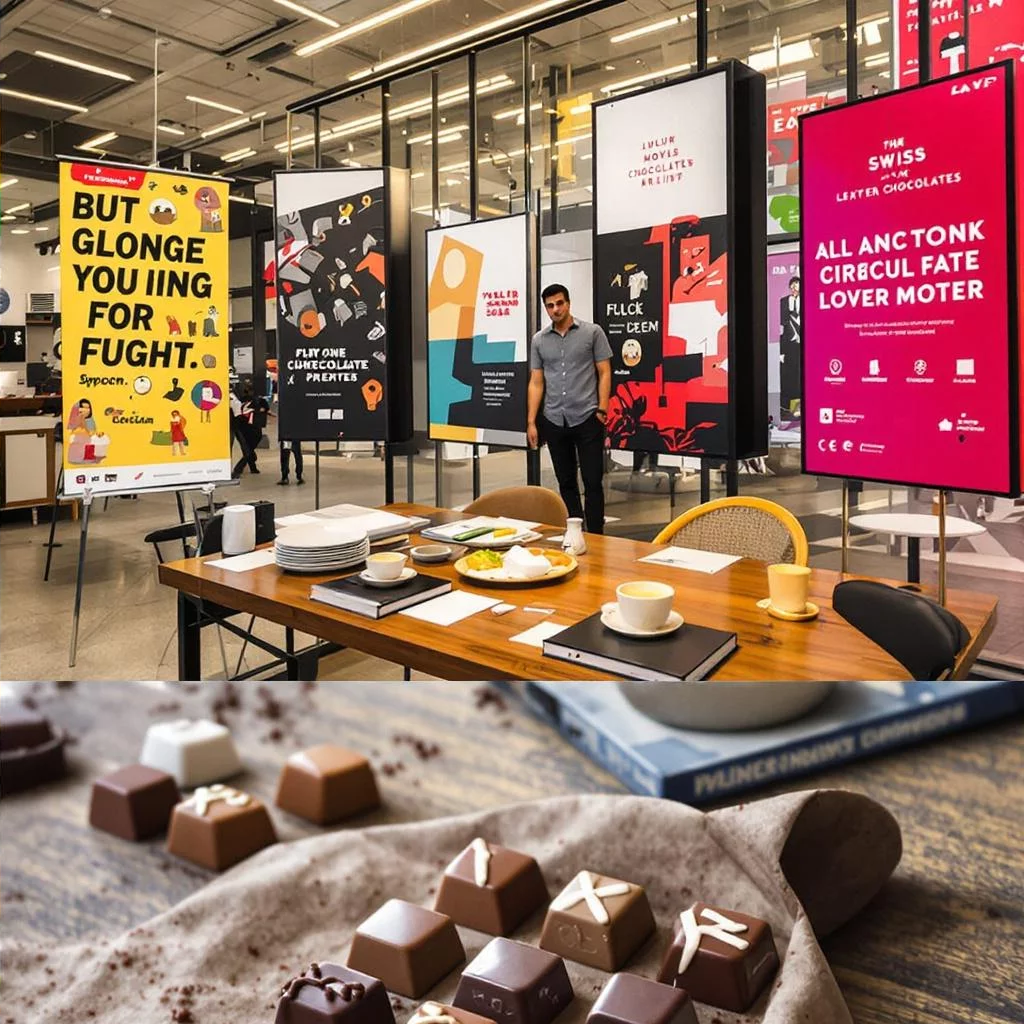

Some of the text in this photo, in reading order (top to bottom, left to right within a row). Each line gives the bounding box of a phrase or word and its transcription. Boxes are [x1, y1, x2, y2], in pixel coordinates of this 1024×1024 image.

[868, 147, 926, 171] SWISS
[882, 172, 961, 195] CHOCOLATES
[72, 191, 140, 224] BUT
[72, 228, 206, 264] GLONGE
[815, 239, 853, 260] ALL
[921, 250, 980, 276] FATE
[73, 264, 139, 295] YOU
[819, 280, 984, 310] LOVER MOTER
[88, 301, 154, 331] FOR
[79, 337, 198, 369] FUGHT.
